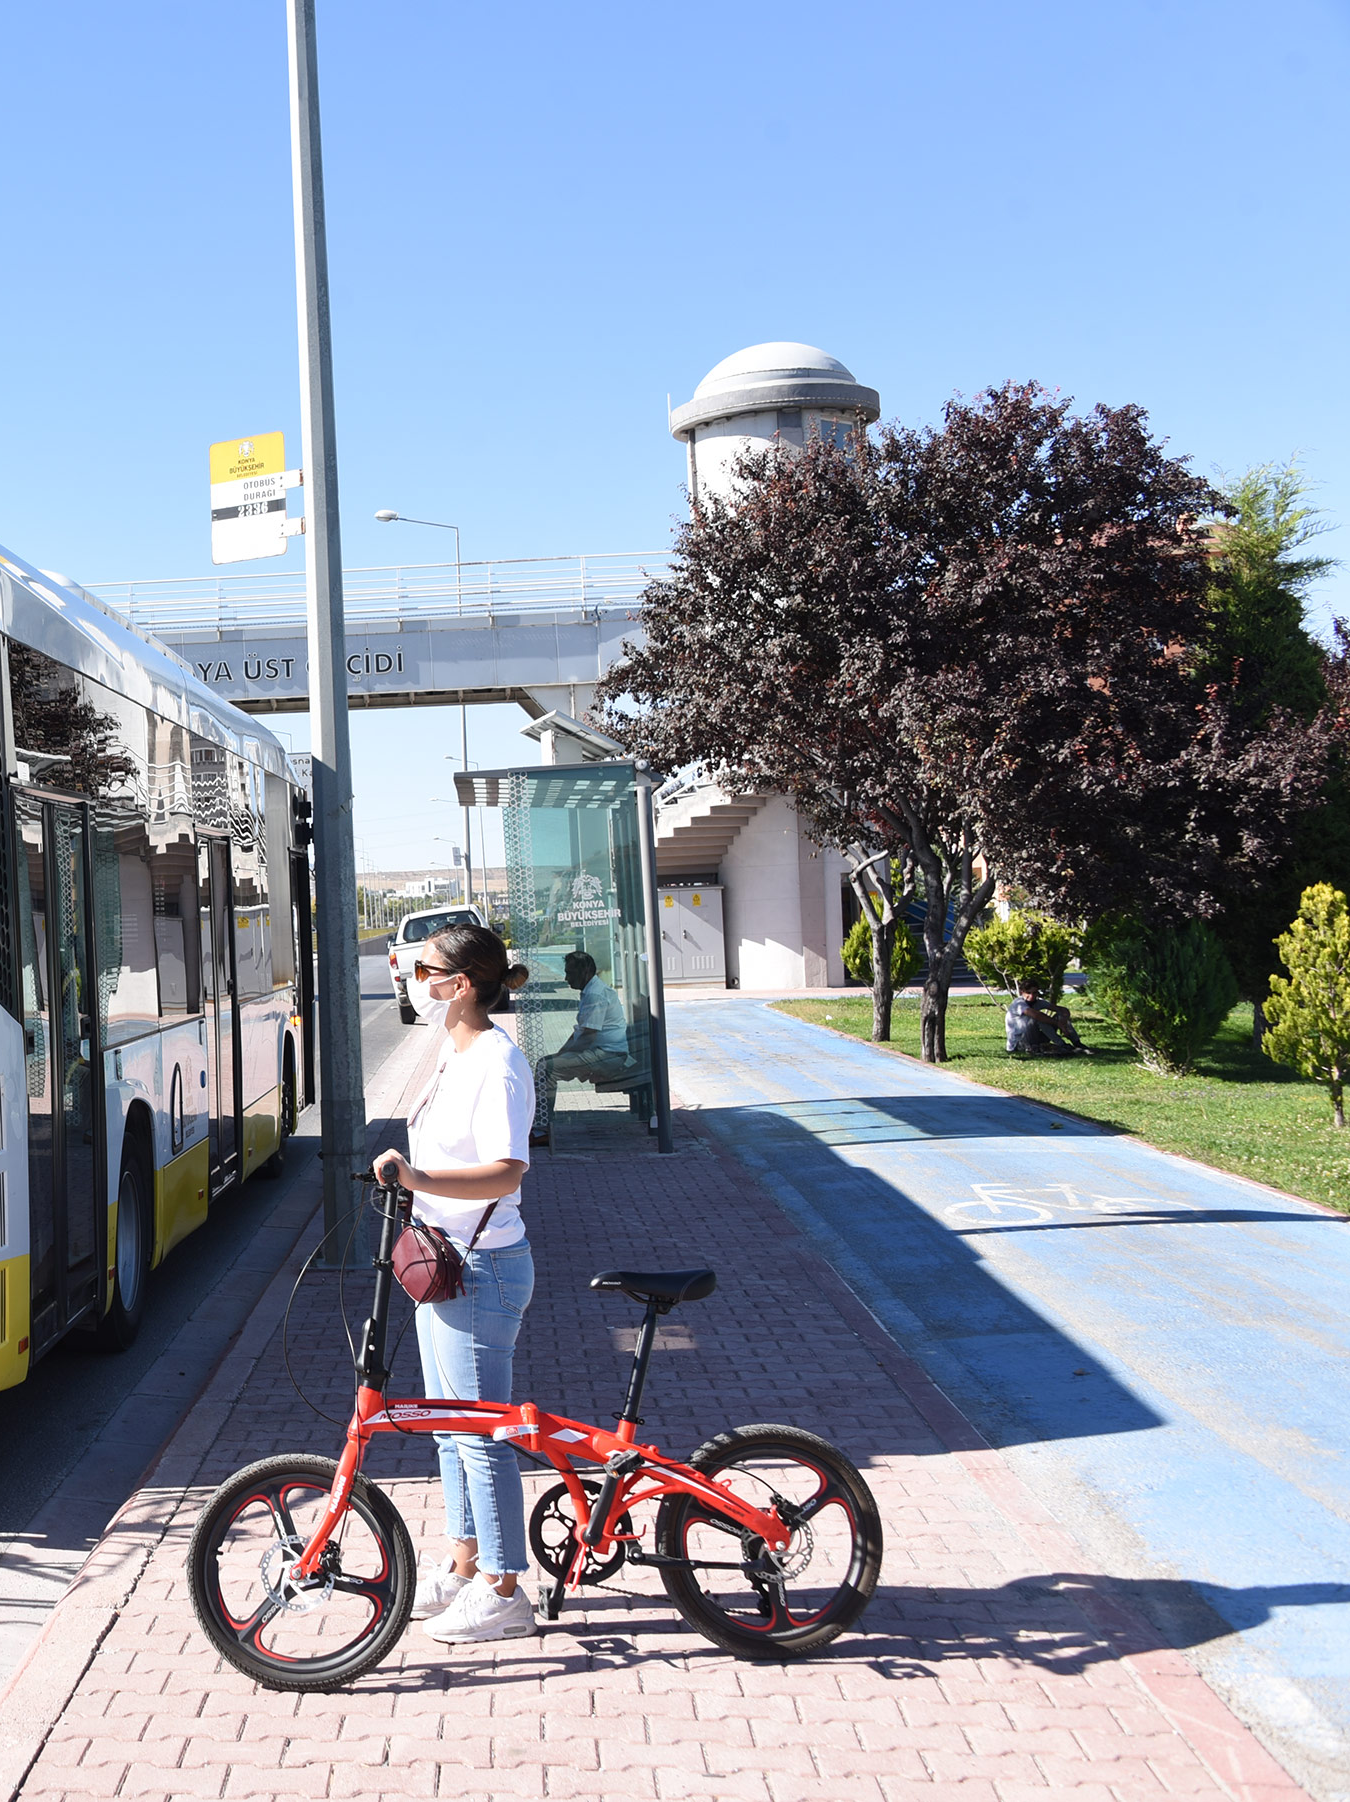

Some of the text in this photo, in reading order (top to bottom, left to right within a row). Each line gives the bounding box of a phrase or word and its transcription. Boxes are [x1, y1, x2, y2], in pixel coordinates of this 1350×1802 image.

[237, 501, 268, 518] 2336
[193, 660, 233, 683] YA
[243, 652, 295, 681] ÜST
[572, 899, 605, 910] KONYA
[557, 908, 621, 922] BÜYÜKŞEHİR
[570, 919, 609, 929] BELEDİYESİ
[379, 1410, 431, 1420] MOSSO
